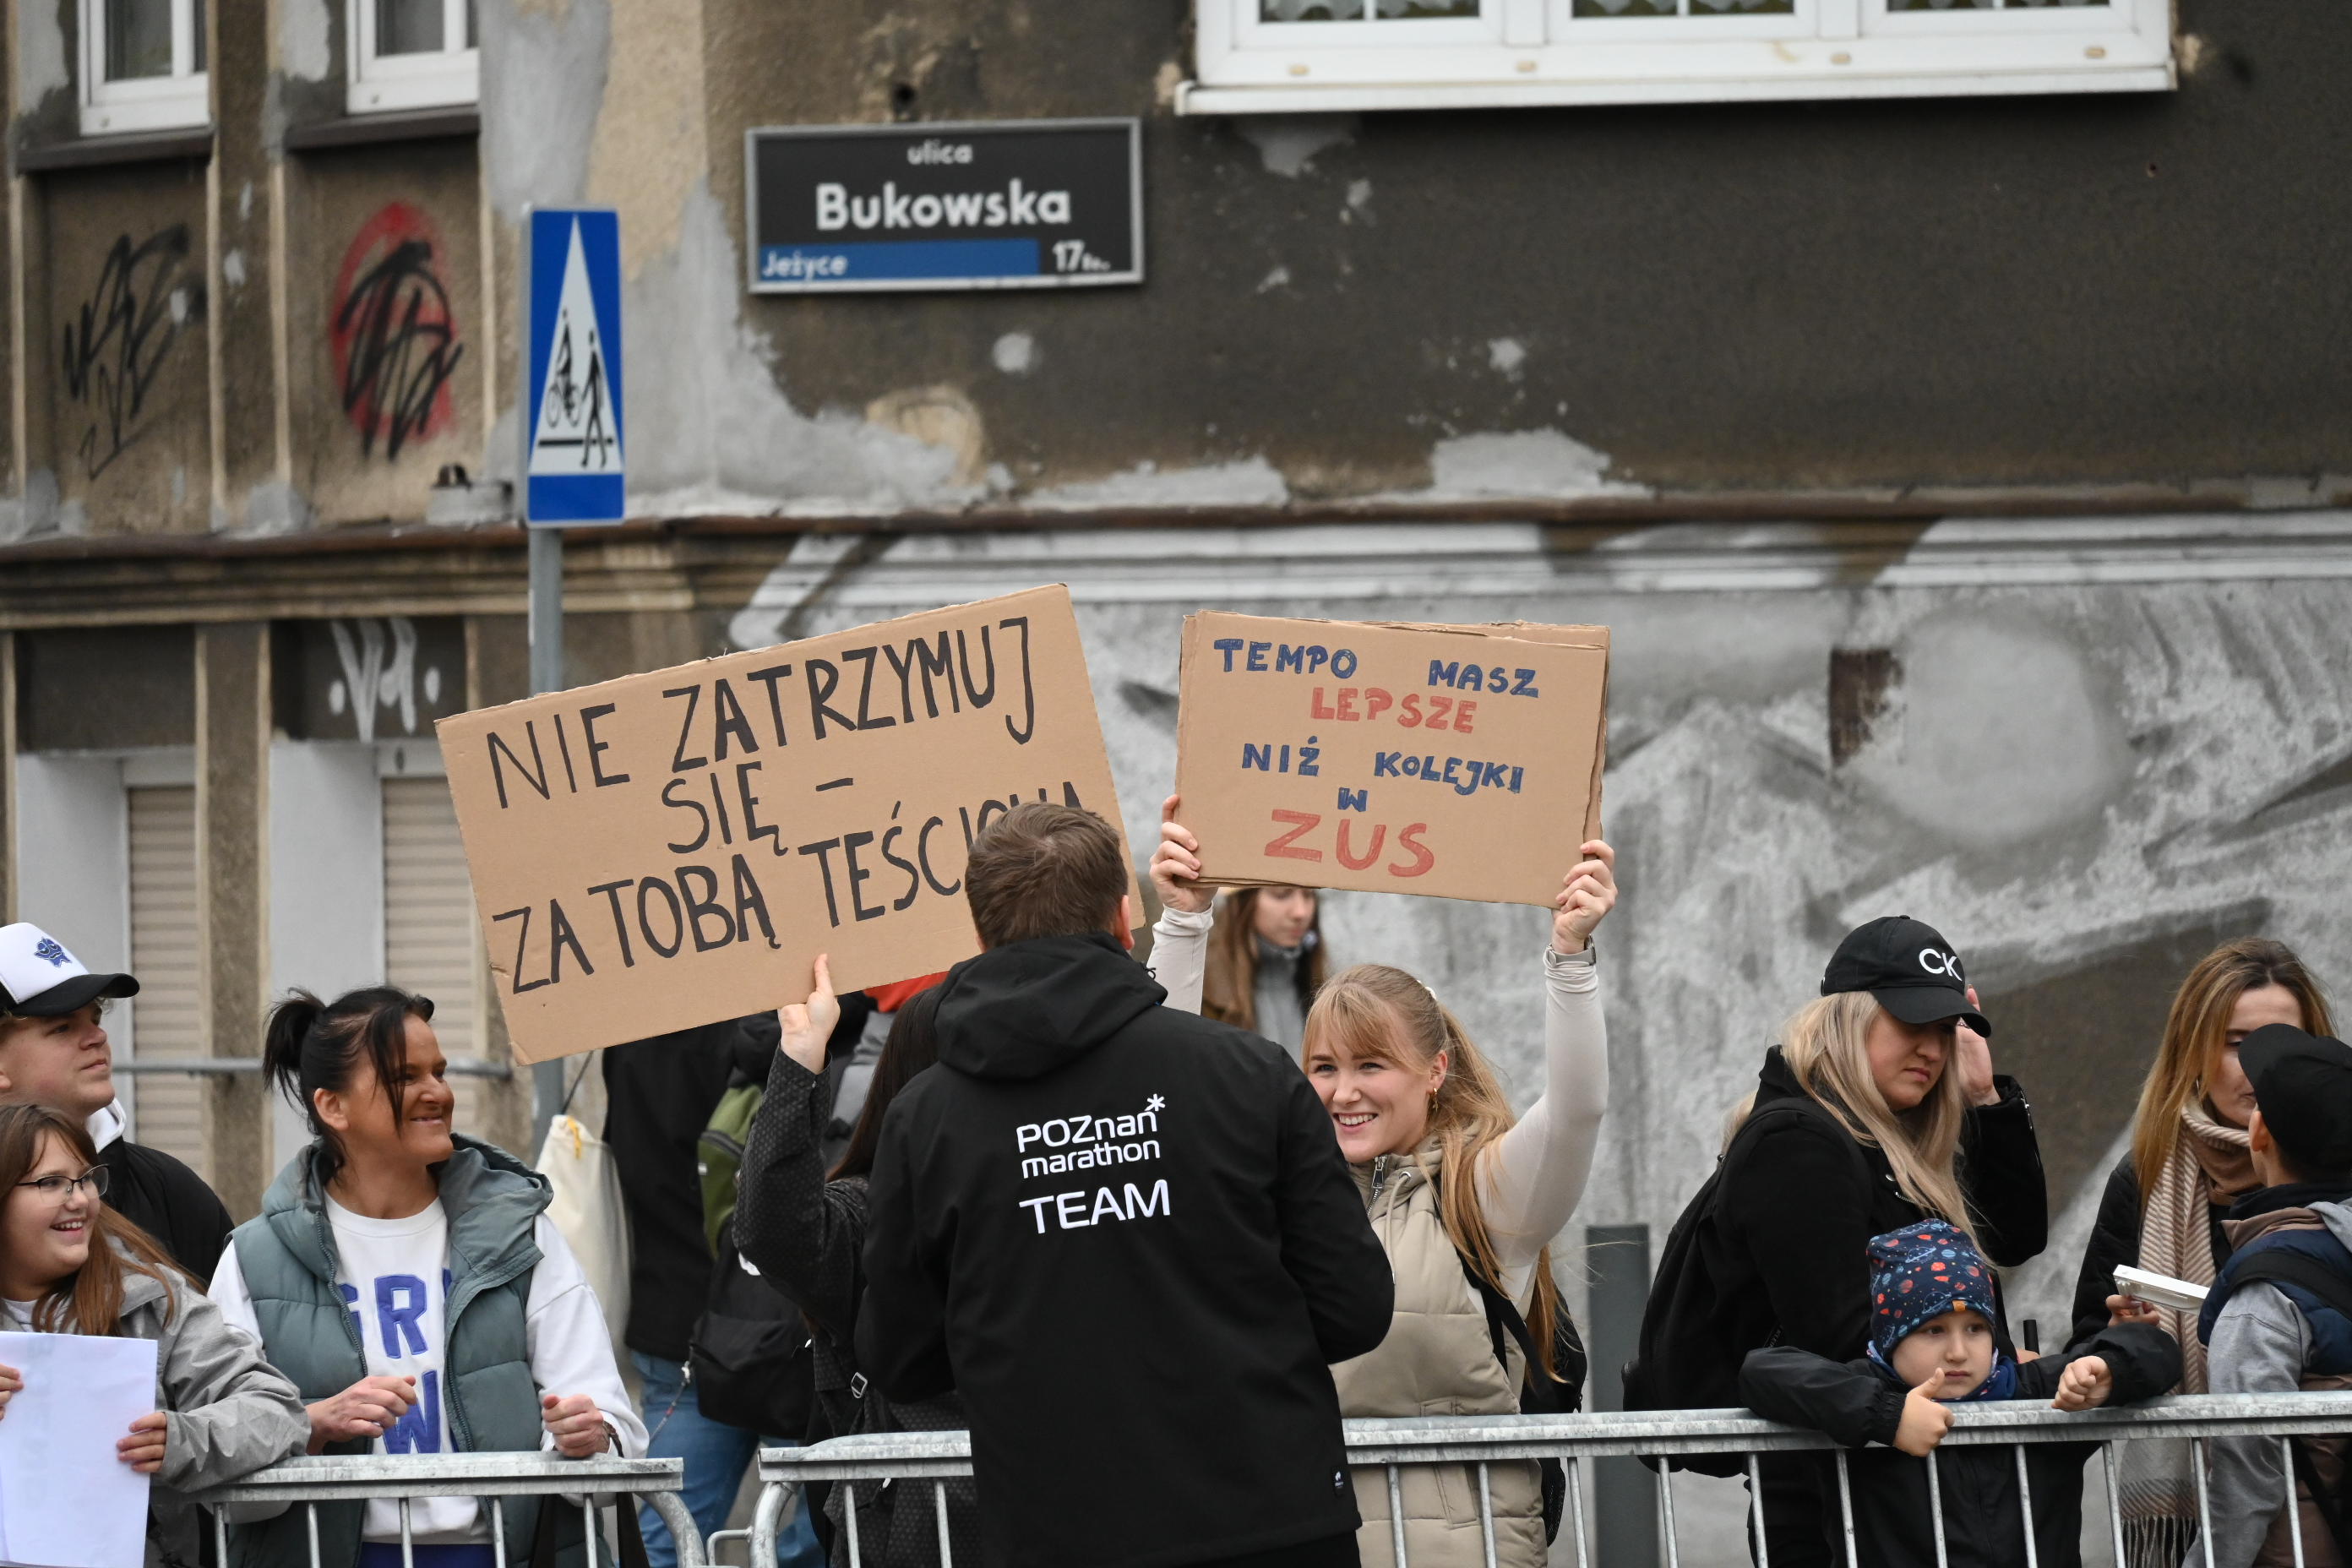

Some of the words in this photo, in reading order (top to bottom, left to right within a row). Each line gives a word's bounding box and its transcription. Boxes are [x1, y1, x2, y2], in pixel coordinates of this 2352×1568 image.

[906, 139, 973, 166] ulica
[815, 177, 1071, 231] Bukowska
[761, 250, 848, 280] Jeżyce
[1213, 638, 1358, 679] TEMPO
[1427, 659, 1539, 699] MASZ
[486, 702, 630, 809] NIE
[662, 616, 1035, 774] ZATRZYMUJ
[1310, 687, 1478, 733] LEPSZE
[1374, 751, 1524, 796] KOLEJKI
[662, 760, 788, 856] SIĘ
[1337, 787, 1368, 813] W
[1263, 808, 1435, 878] ZUS
[492, 898, 596, 994] ZA
[587, 852, 782, 967] TOBĄ
[1919, 948, 1963, 982] CK
[1021, 1139, 1161, 1179] marathon
[1018, 1179, 1171, 1234] TEAM
